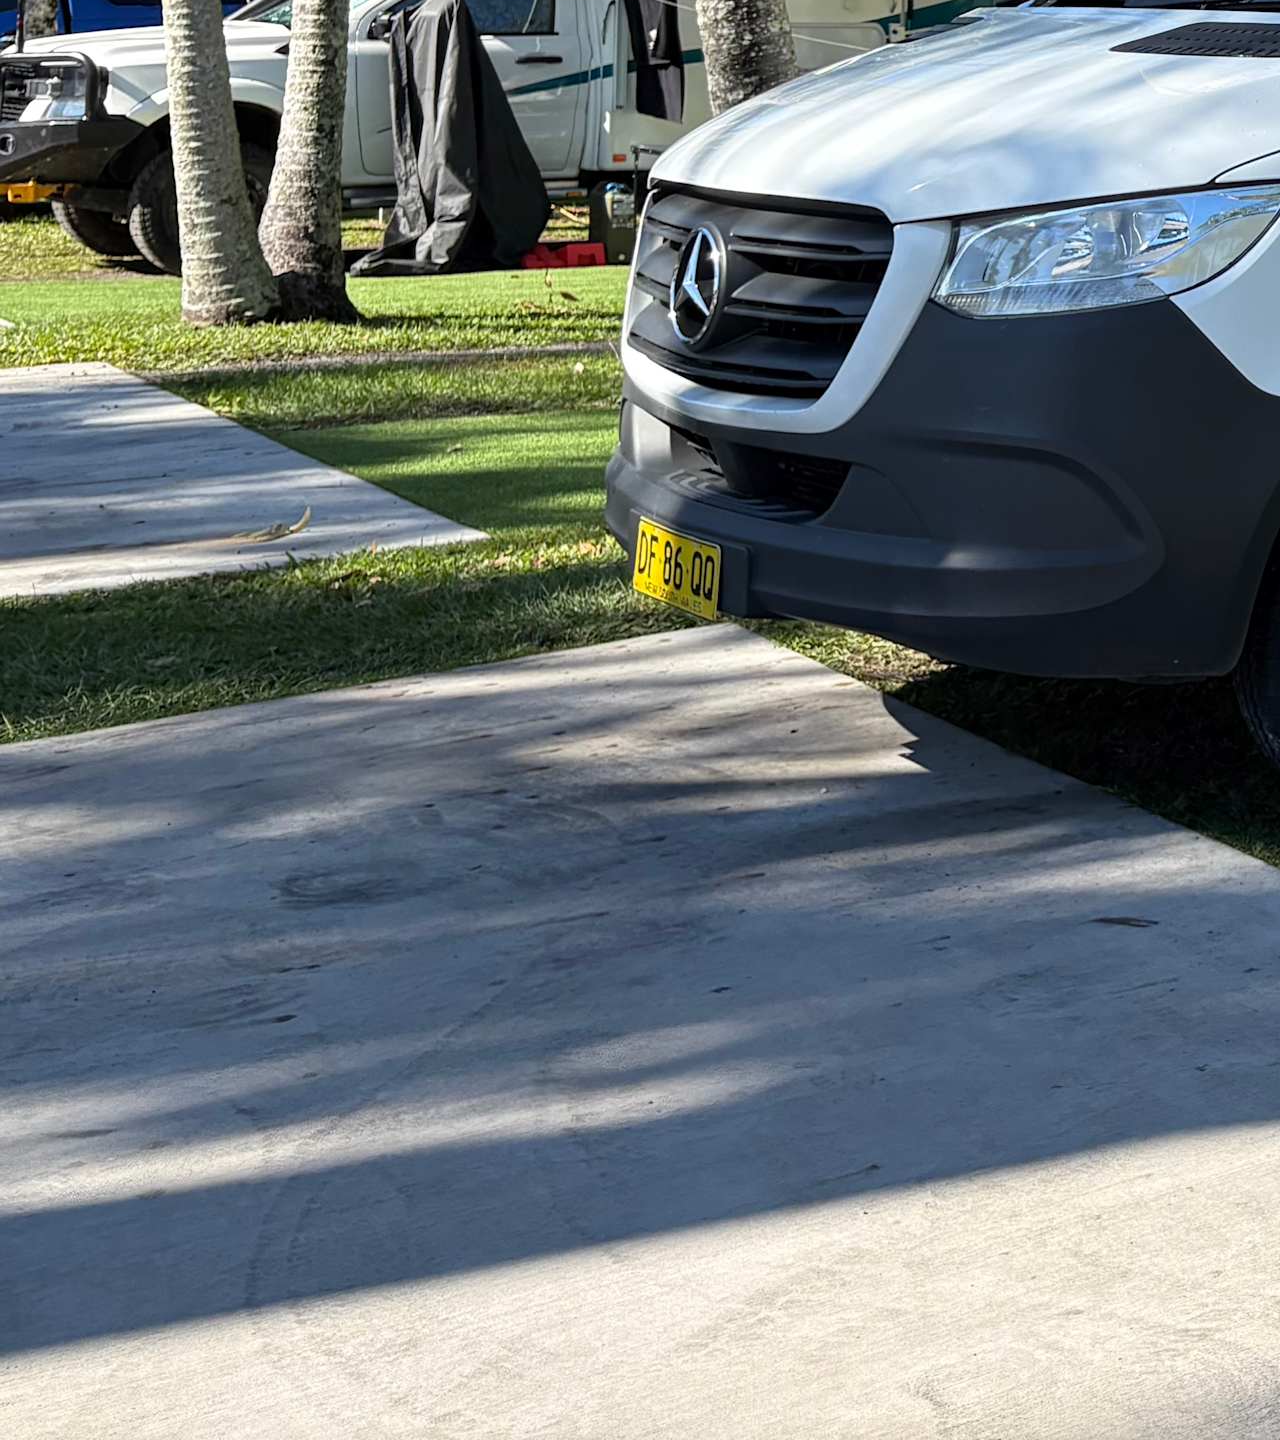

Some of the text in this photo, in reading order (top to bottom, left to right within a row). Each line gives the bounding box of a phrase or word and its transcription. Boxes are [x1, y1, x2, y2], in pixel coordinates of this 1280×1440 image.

[638, 530, 715, 601] DF 86 QQ
